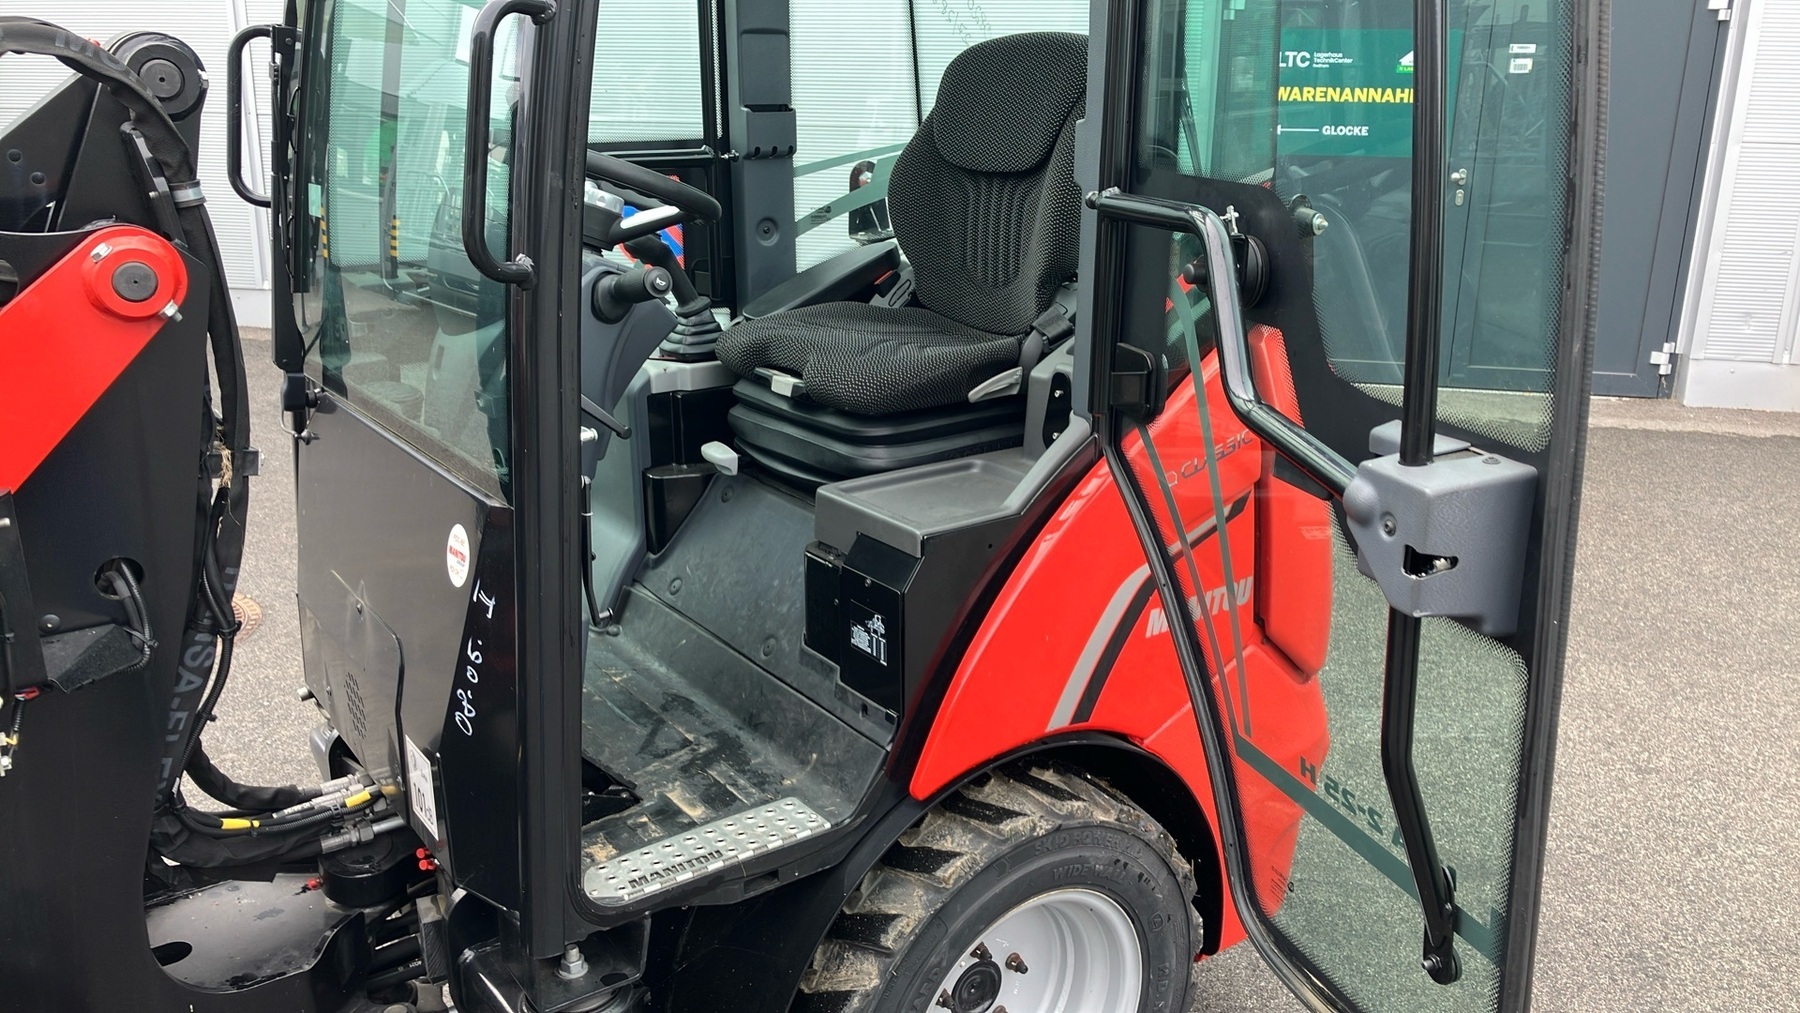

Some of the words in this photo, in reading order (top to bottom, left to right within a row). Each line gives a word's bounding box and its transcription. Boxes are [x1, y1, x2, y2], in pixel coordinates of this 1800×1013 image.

[1279, 51, 1311, 68] LTC
[1313, 51, 1343, 59] Lagerhaus
[1278, 86, 1413, 103] WARENANNAH
[1322, 125, 1369, 136] GLOCKE
[628, 849, 724, 889] MANITOU
